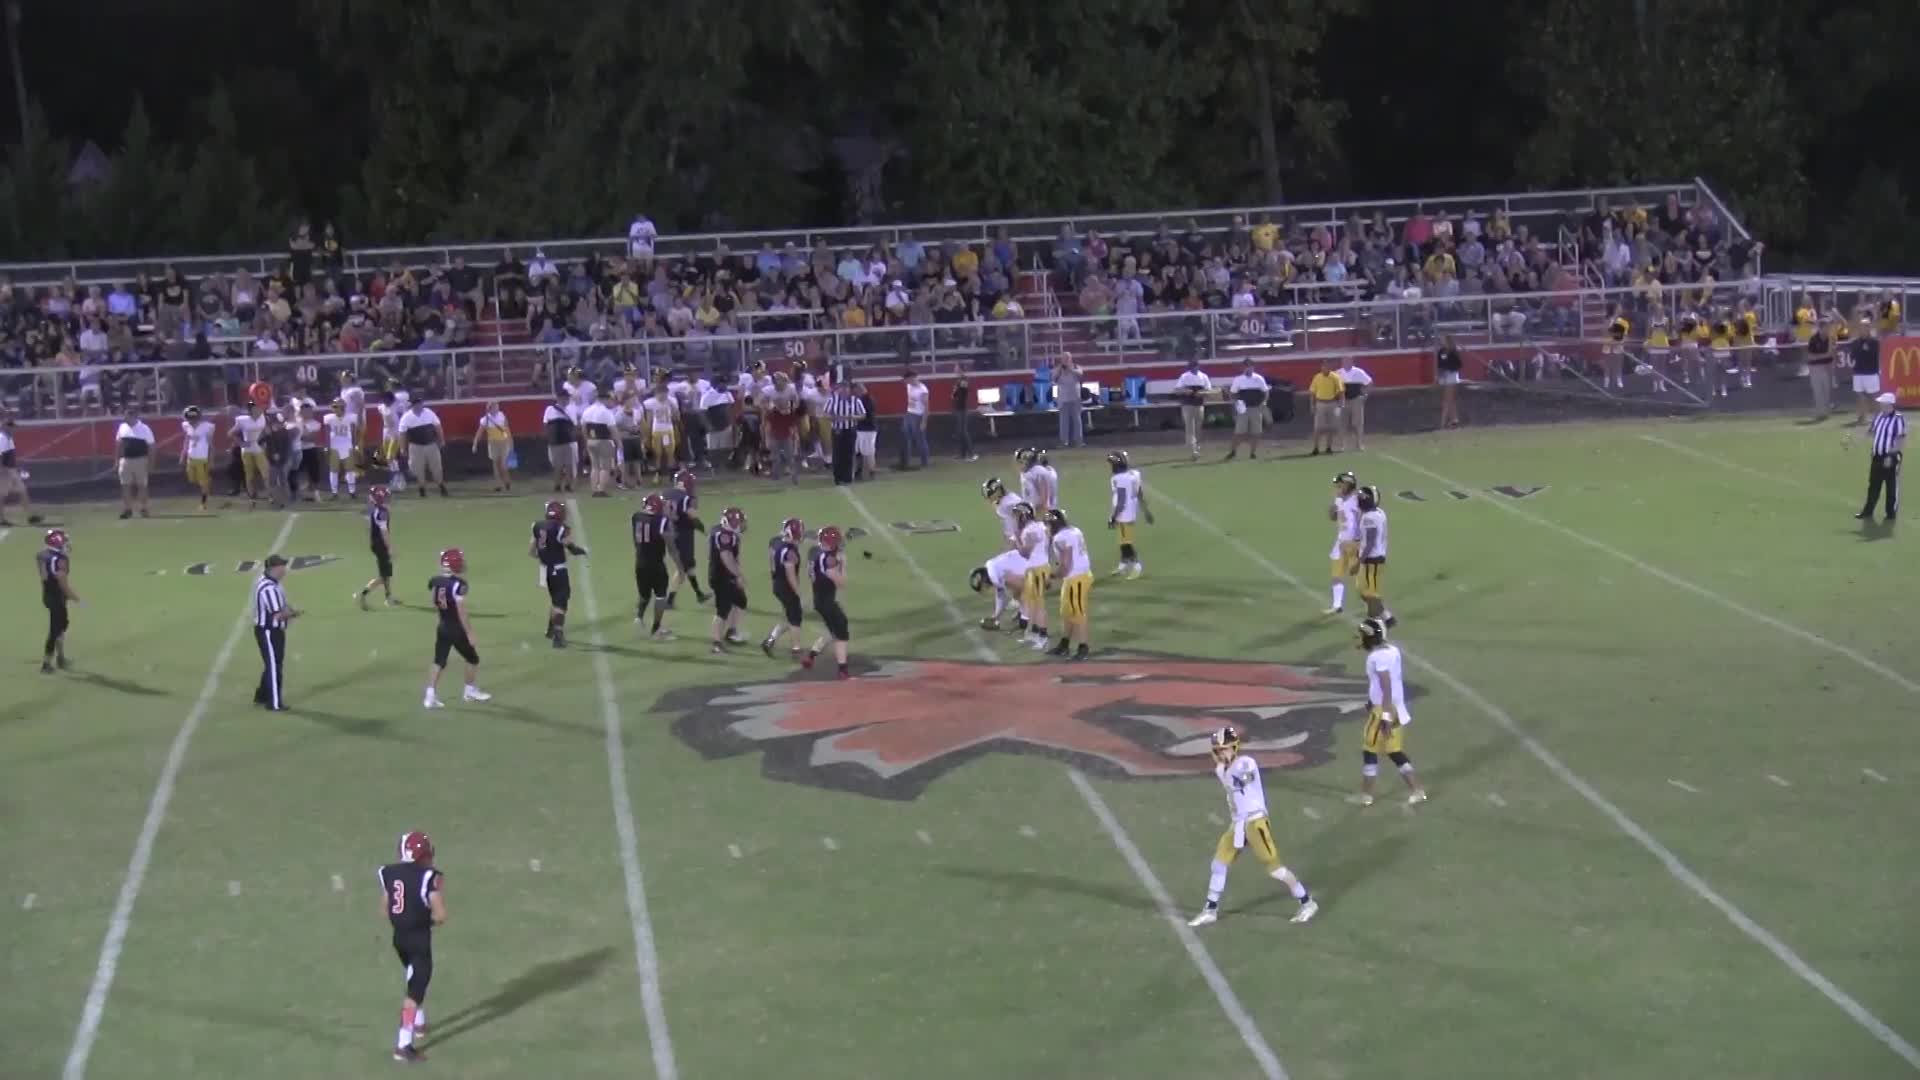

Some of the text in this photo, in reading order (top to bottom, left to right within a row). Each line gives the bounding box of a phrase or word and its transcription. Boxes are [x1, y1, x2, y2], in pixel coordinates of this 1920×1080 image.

[784, 340, 805, 358] 50
[296, 365, 318, 382] 40
[391, 879, 405, 914] 3
